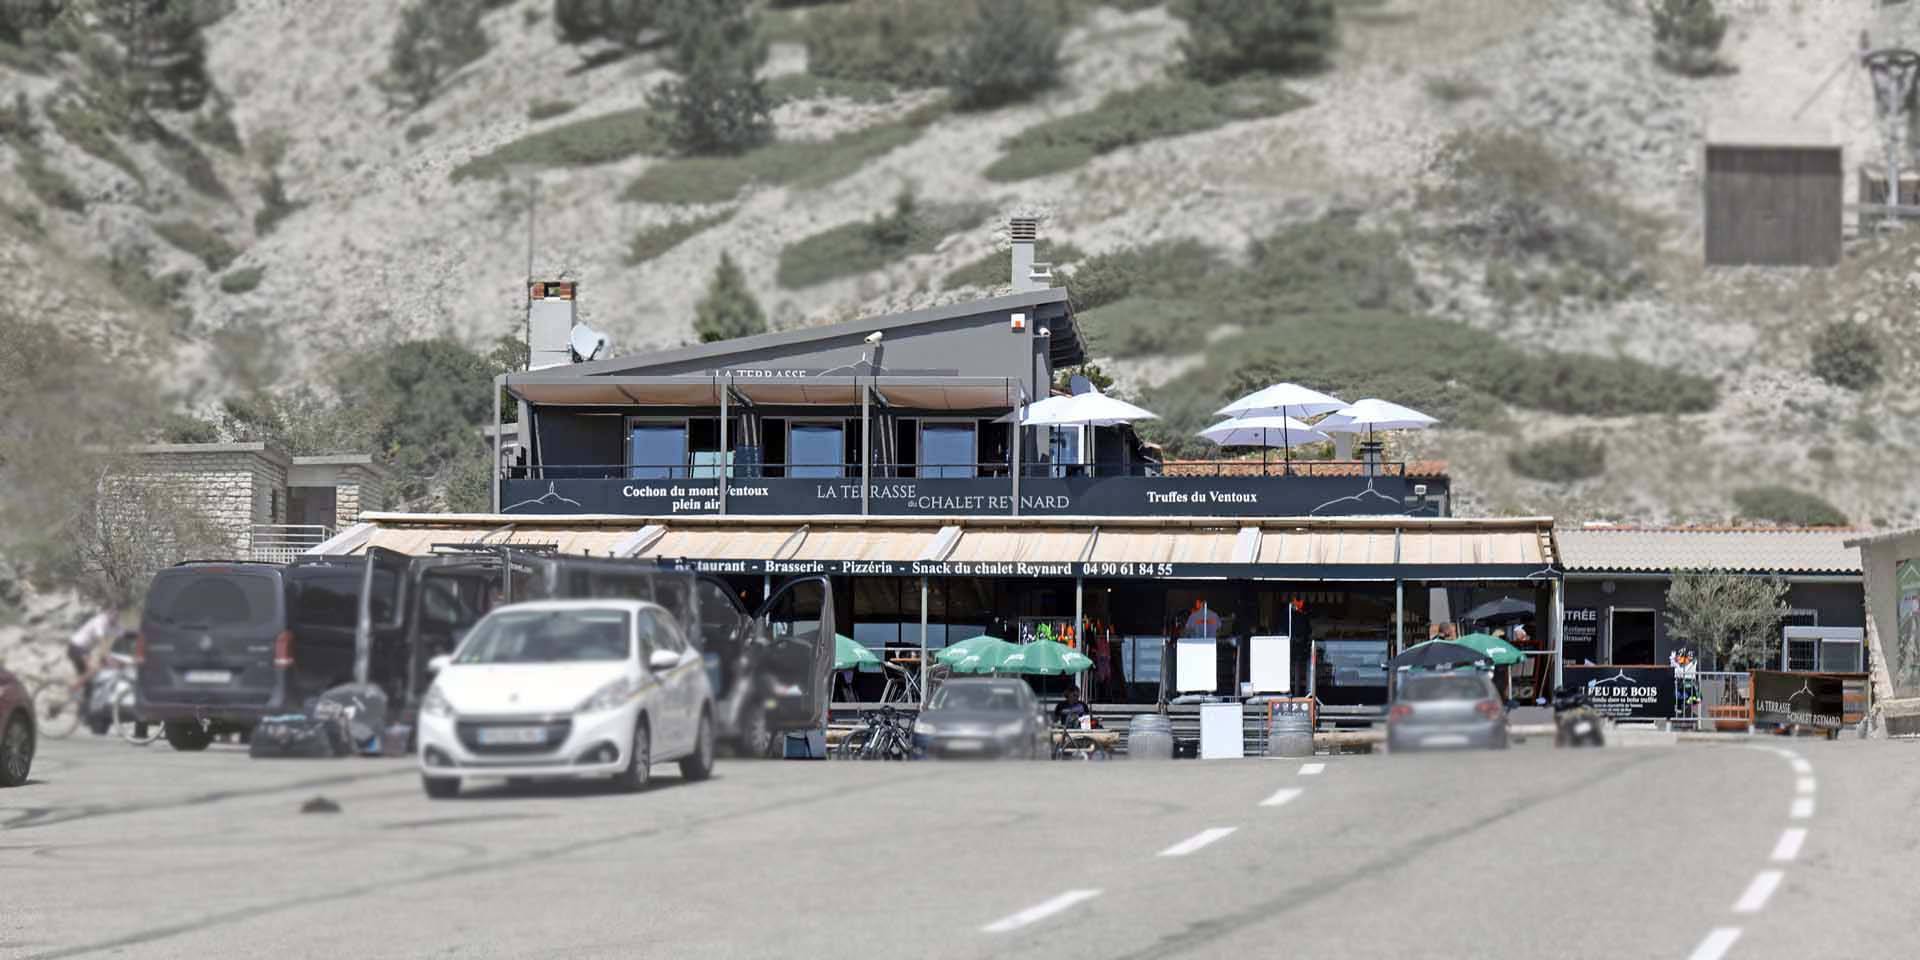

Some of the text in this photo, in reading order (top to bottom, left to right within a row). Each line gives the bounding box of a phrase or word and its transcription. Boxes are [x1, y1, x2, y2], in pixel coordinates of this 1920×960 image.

[623, 485, 668, 497] Cochon
[670, 485, 685, 497] du
[688, 486, 719, 497] mont
[817, 485, 837, 498] LA
[1147, 491, 1257, 503] Truffes du Ventoux
[672, 498, 720, 512] plein air
[918, 496, 985, 509] CHALET
[675, 559, 746, 572] Rtaurant
[765, 560, 824, 573] Brasserie
[842, 561, 893, 573] Pizzéria
[912, 562, 950, 575] Snack
[955, 562, 971, 575] du
[974, 562, 1013, 575] chalet
[1016, 562, 1072, 577] Reynard
[1083, 562, 1097, 575] 04
[1101, 562, 1116, 575] 90
[1120, 562, 1134, 575] 61
[1138, 562, 1153, 575] 84
[1157, 562, 1172, 575] 55
[1612, 687, 1628, 697] DE
[1630, 686, 1657, 697] BOIS
[1756, 700, 1792, 714] LA TERRASSE
